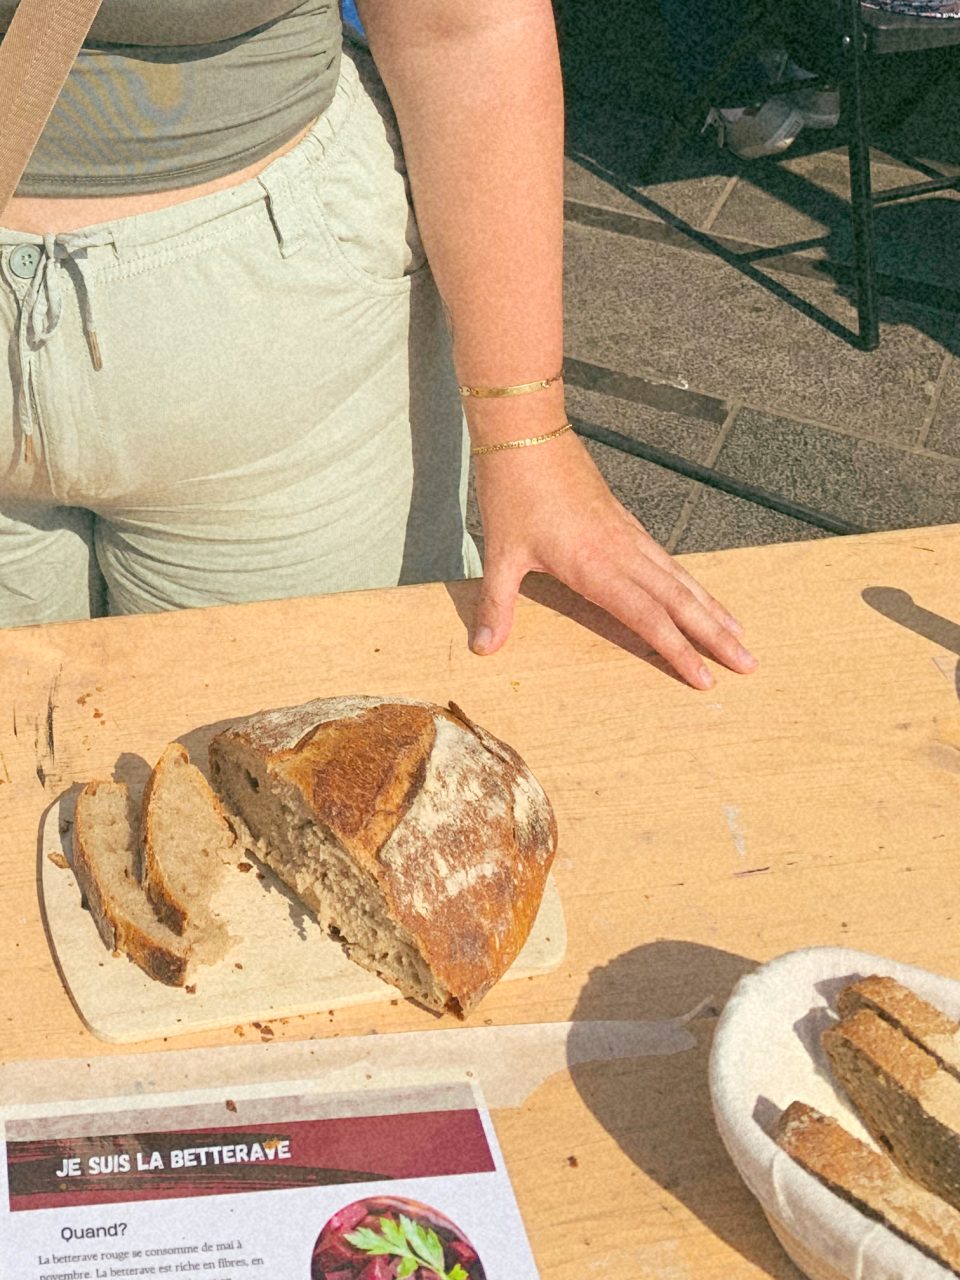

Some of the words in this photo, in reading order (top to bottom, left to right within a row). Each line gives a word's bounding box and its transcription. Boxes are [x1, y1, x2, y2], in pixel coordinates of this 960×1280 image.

[55, 1158, 82, 1178] JE
[88, 1154, 131, 1175] SUIS
[136, 1151, 164, 1171] LA
[170, 1140, 292, 1168] BETTERAVE
[60, 1222, 128, 1242] Quand?
[38, 1255, 50, 1266] La
[53, 1251, 98, 1264] betterave
[100, 1249, 130, 1261] rouge
[132, 1248, 142, 1258] se
[145, 1245, 199, 1258] consomme
[201, 1242, 214, 1253] de
[216, 1240, 235, 1252] mai
[236, 1239, 243, 1250] à
[95, 1268, 108, 1279] La
[110, 1264, 156, 1278] betterave
[158, 1263, 172, 1273] est
[175, 1260, 201, 1272] riche
[203, 1261, 216, 1270] en
[218, 1257, 249, 1269] fibres,
[251, 1257, 264, 1266] en
